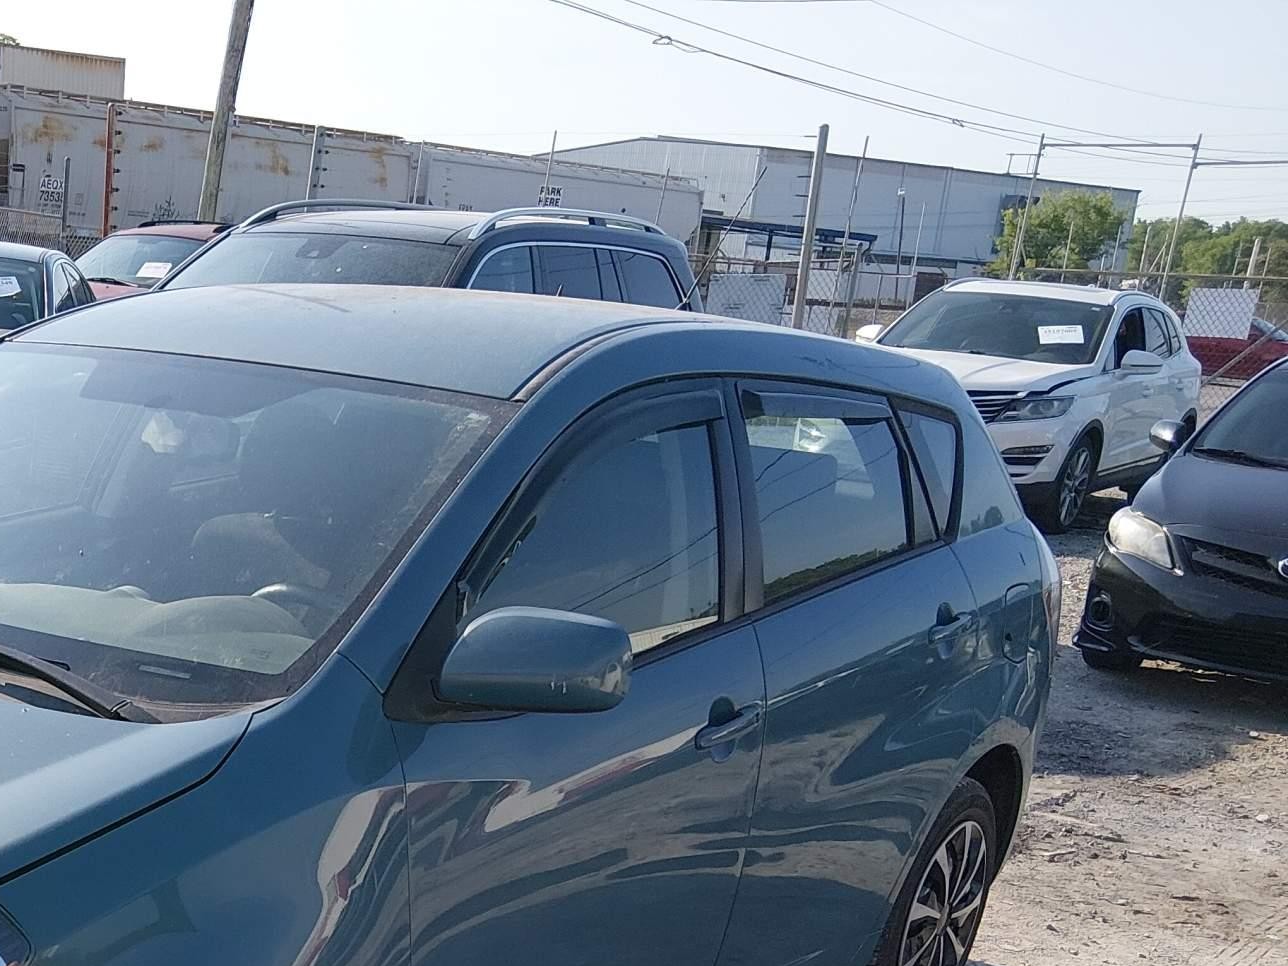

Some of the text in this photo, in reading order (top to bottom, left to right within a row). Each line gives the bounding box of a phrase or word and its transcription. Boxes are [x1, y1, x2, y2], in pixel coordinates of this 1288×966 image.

[40, 178, 64, 190] AEQX
[39, 191, 64, 202] 7353
[539, 187, 562, 196] PARK
[538, 197, 561, 206] HERE
